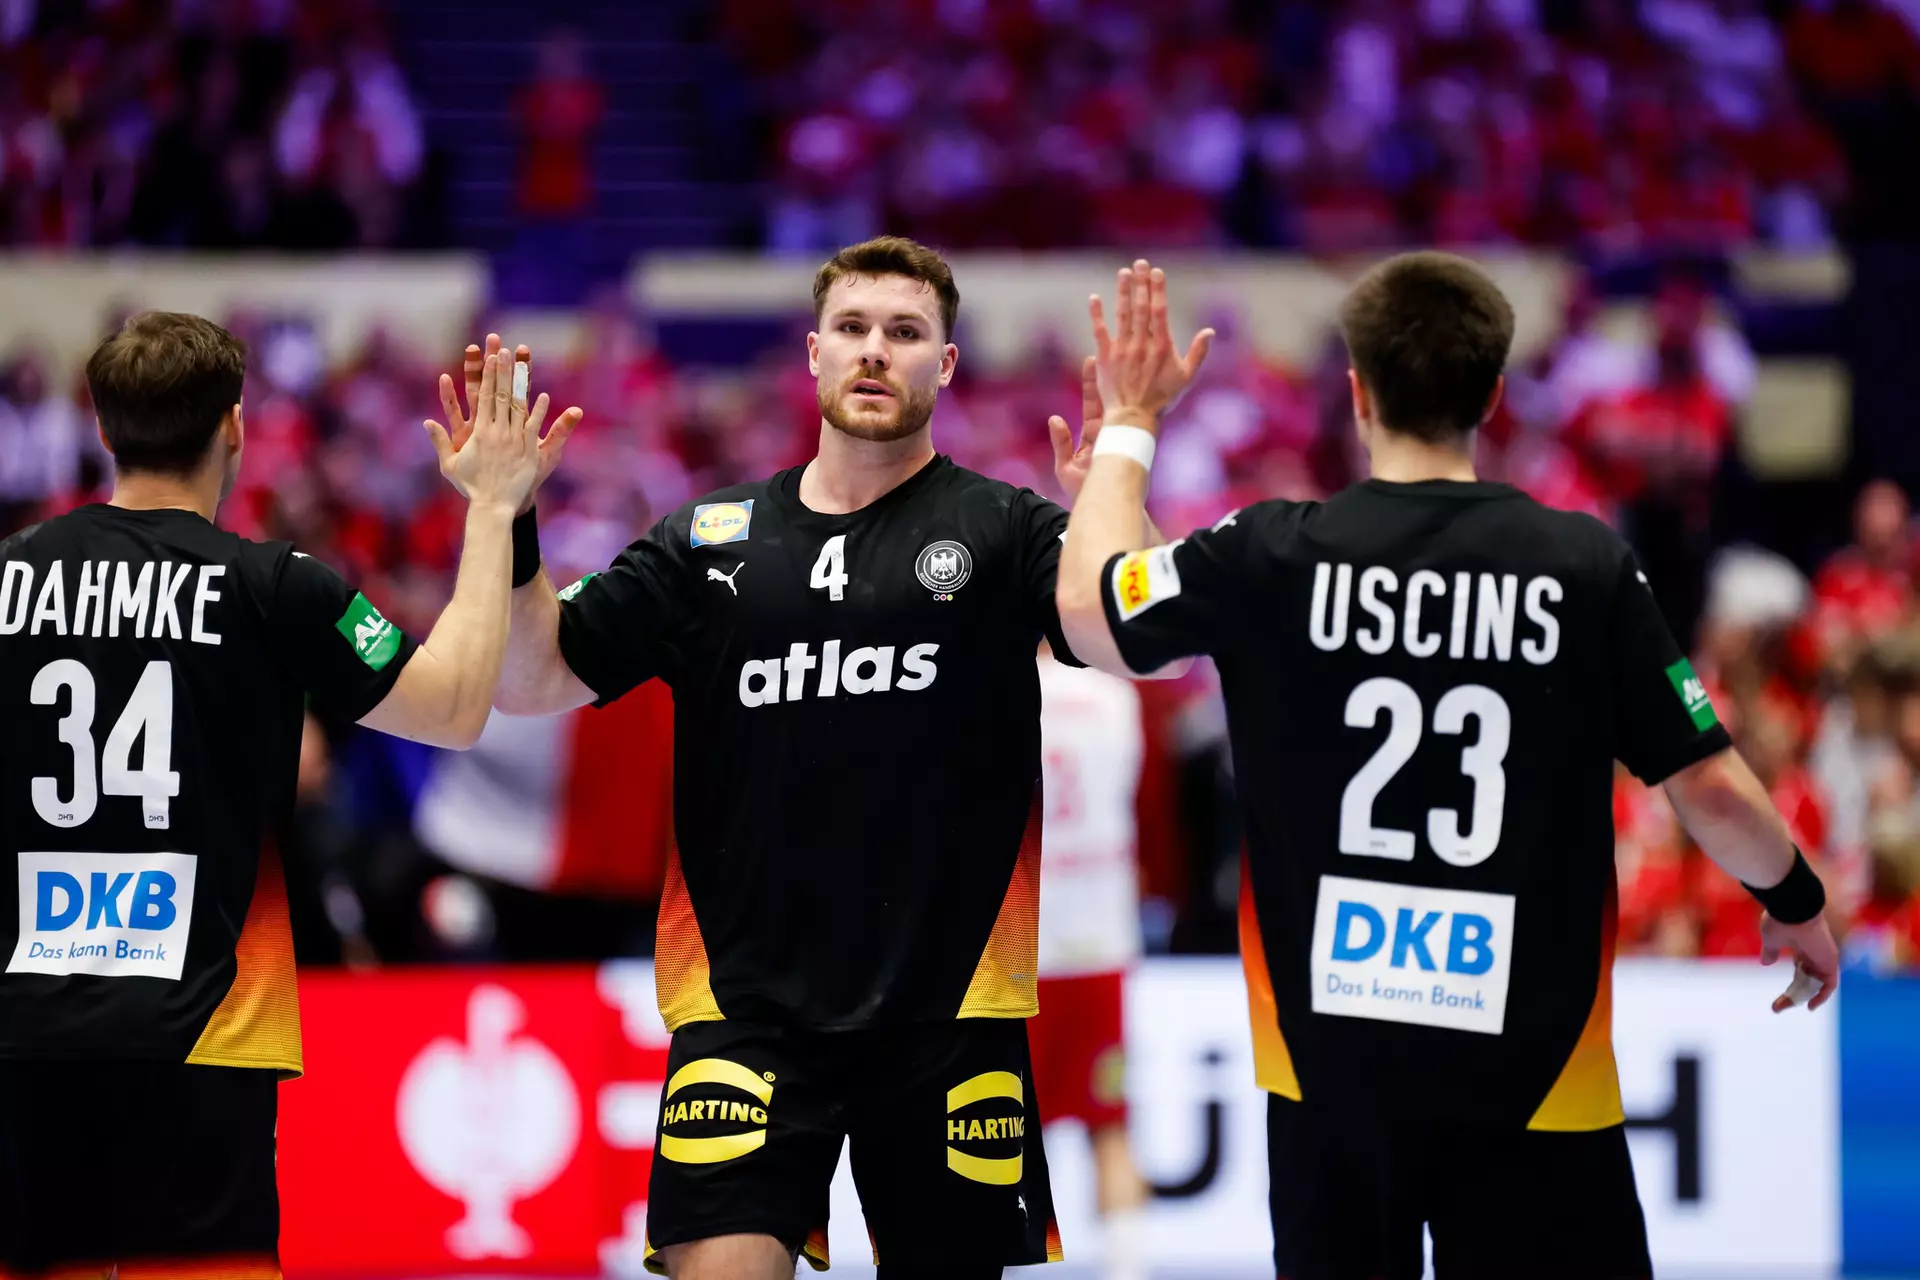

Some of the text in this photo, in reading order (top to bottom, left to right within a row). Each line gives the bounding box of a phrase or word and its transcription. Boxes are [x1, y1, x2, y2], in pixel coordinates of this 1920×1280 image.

[0, 560, 226, 645] DAHMKE
[810, 534, 849, 602] 4
[1309, 562, 1564, 665] USCINS
[739, 639, 940, 708] atlas
[30, 659, 181, 830] 34
[1338, 677, 1511, 867] 23
[36, 870, 177, 932] DKB
[28, 939, 167, 962] Das kann Bank
[1330, 900, 1495, 977] DKB
[1326, 974, 1486, 1011] Das kann Bank
[663, 1100, 768, 1128] HARTING
